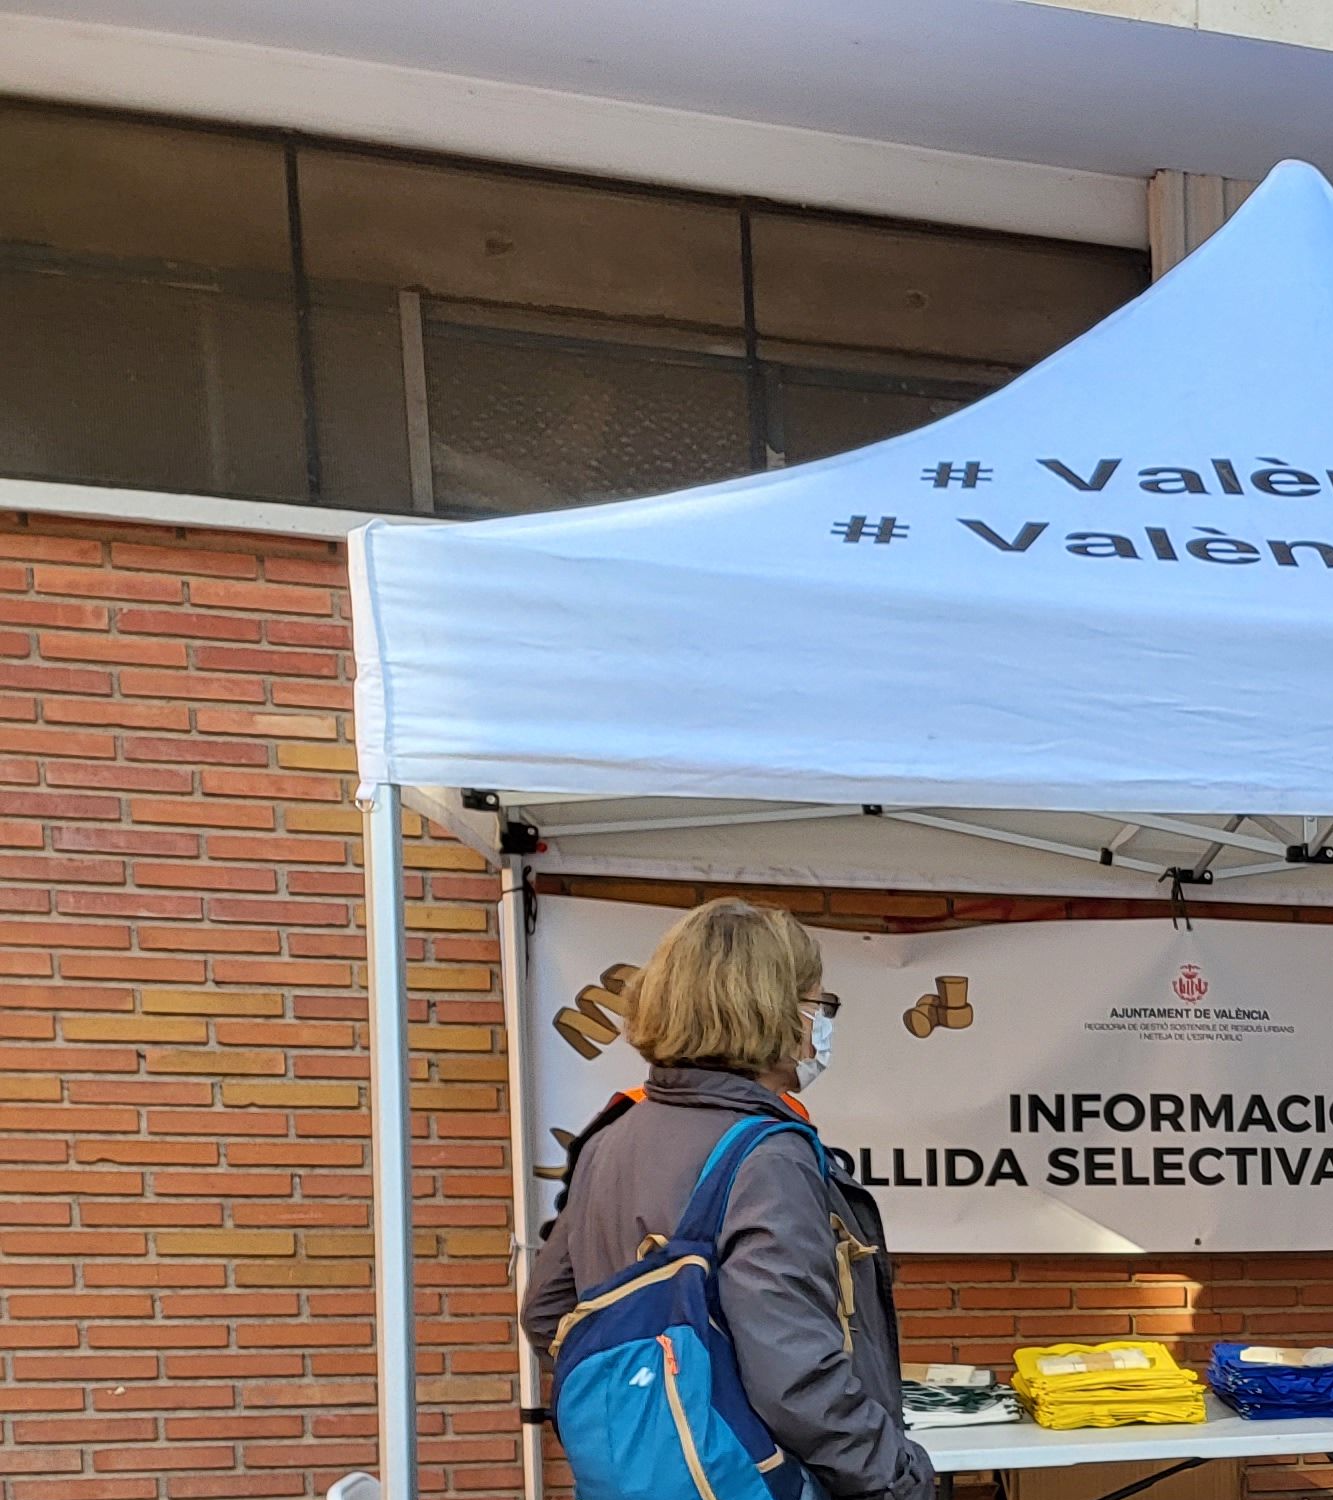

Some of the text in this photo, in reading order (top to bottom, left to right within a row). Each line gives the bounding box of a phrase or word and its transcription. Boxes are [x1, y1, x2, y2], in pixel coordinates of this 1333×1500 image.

[922, 461, 993, 489] #
[831, 515, 910, 544] #
[1110, 1007, 1270, 1021] AJUNTAMENT DE VALÈNCIA
[1127, 1023, 1138, 1031] DE
[1219, 1024, 1230, 1033] DE
[1174, 1033, 1185, 1041] DE
